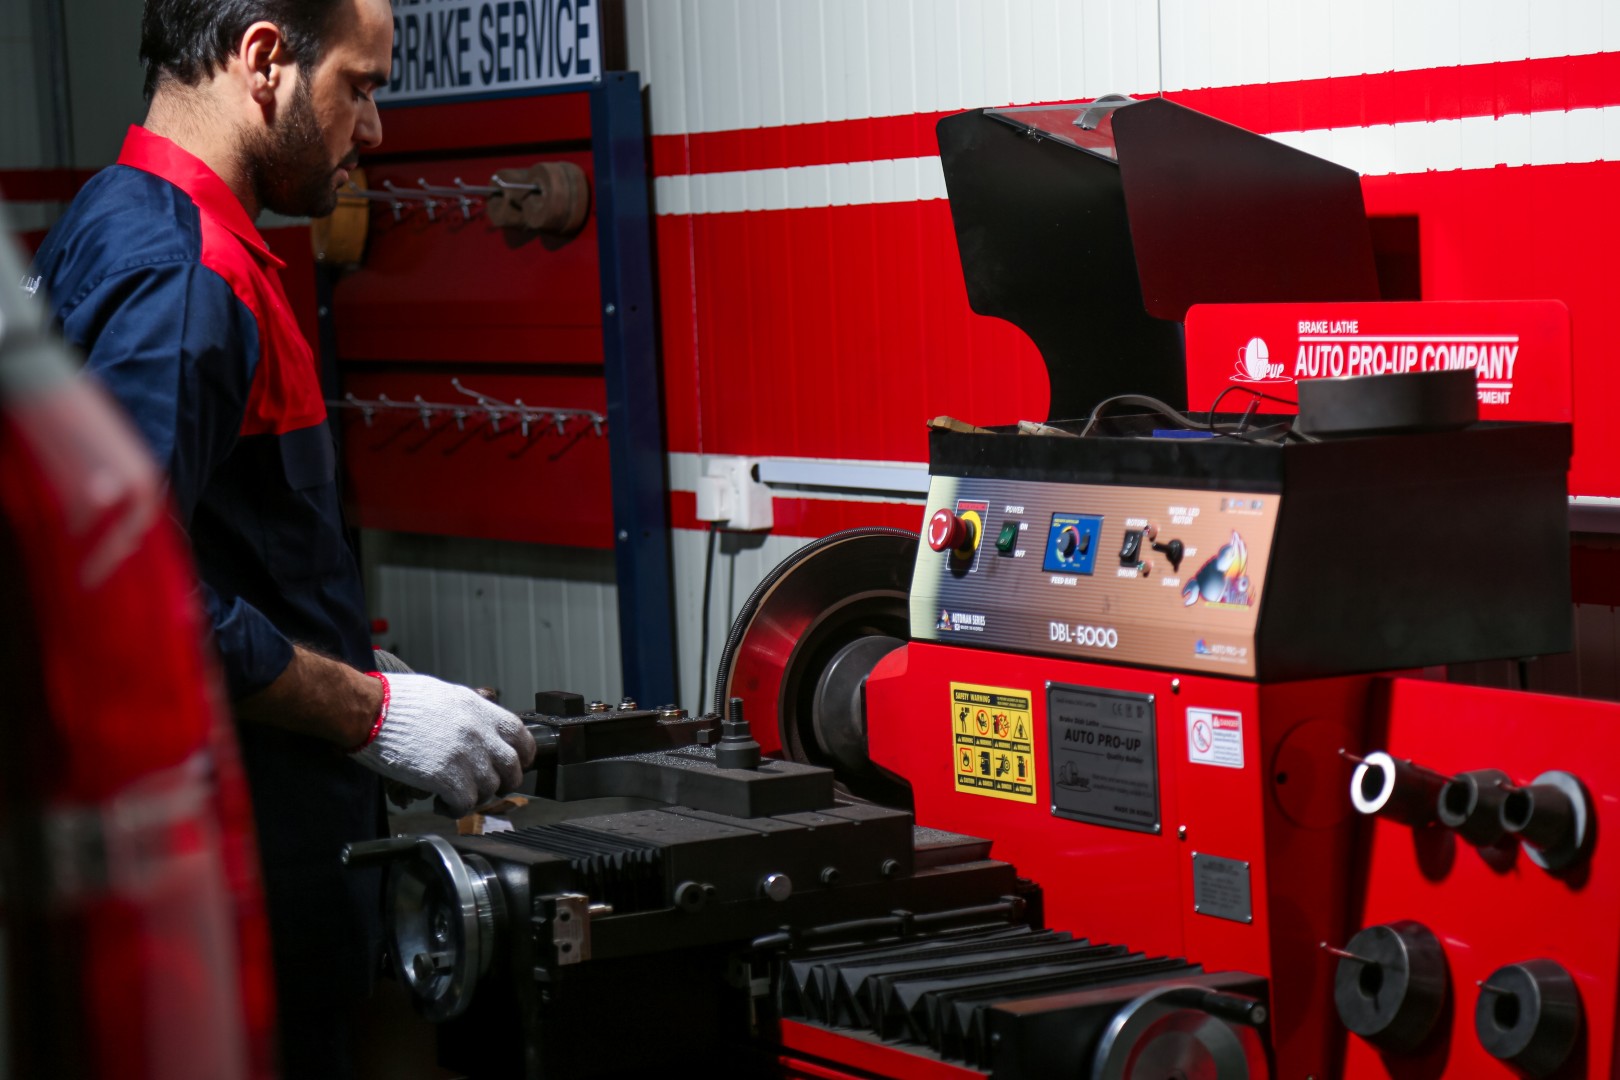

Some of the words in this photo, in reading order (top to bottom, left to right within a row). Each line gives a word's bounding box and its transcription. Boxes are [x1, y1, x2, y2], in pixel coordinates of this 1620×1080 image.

[390, 7, 471, 93] BRAKE
[478, 0, 591, 85] SERVICE
[1298, 320, 1329, 334] BRAKE
[1330, 320, 1359, 334] LATHE
[1294, 345, 1345, 378] AUTO
[1347, 345, 1419, 377] PRO-UP
[1421, 344, 1519, 380] COMPANY
[1477, 391, 1511, 405] PMENT
[1005, 505, 1025, 515] POWER
[1014, 550, 1026, 558] OFF
[1051, 623, 1118, 648] DBL-5000
[955, 691, 969, 701] SAFETY
[970, 693, 990, 704] WARNING
[1059, 715, 1074, 725] Brake
[1065, 728, 1095, 745] AUTO
[1097, 734, 1142, 752] PRO-UP
